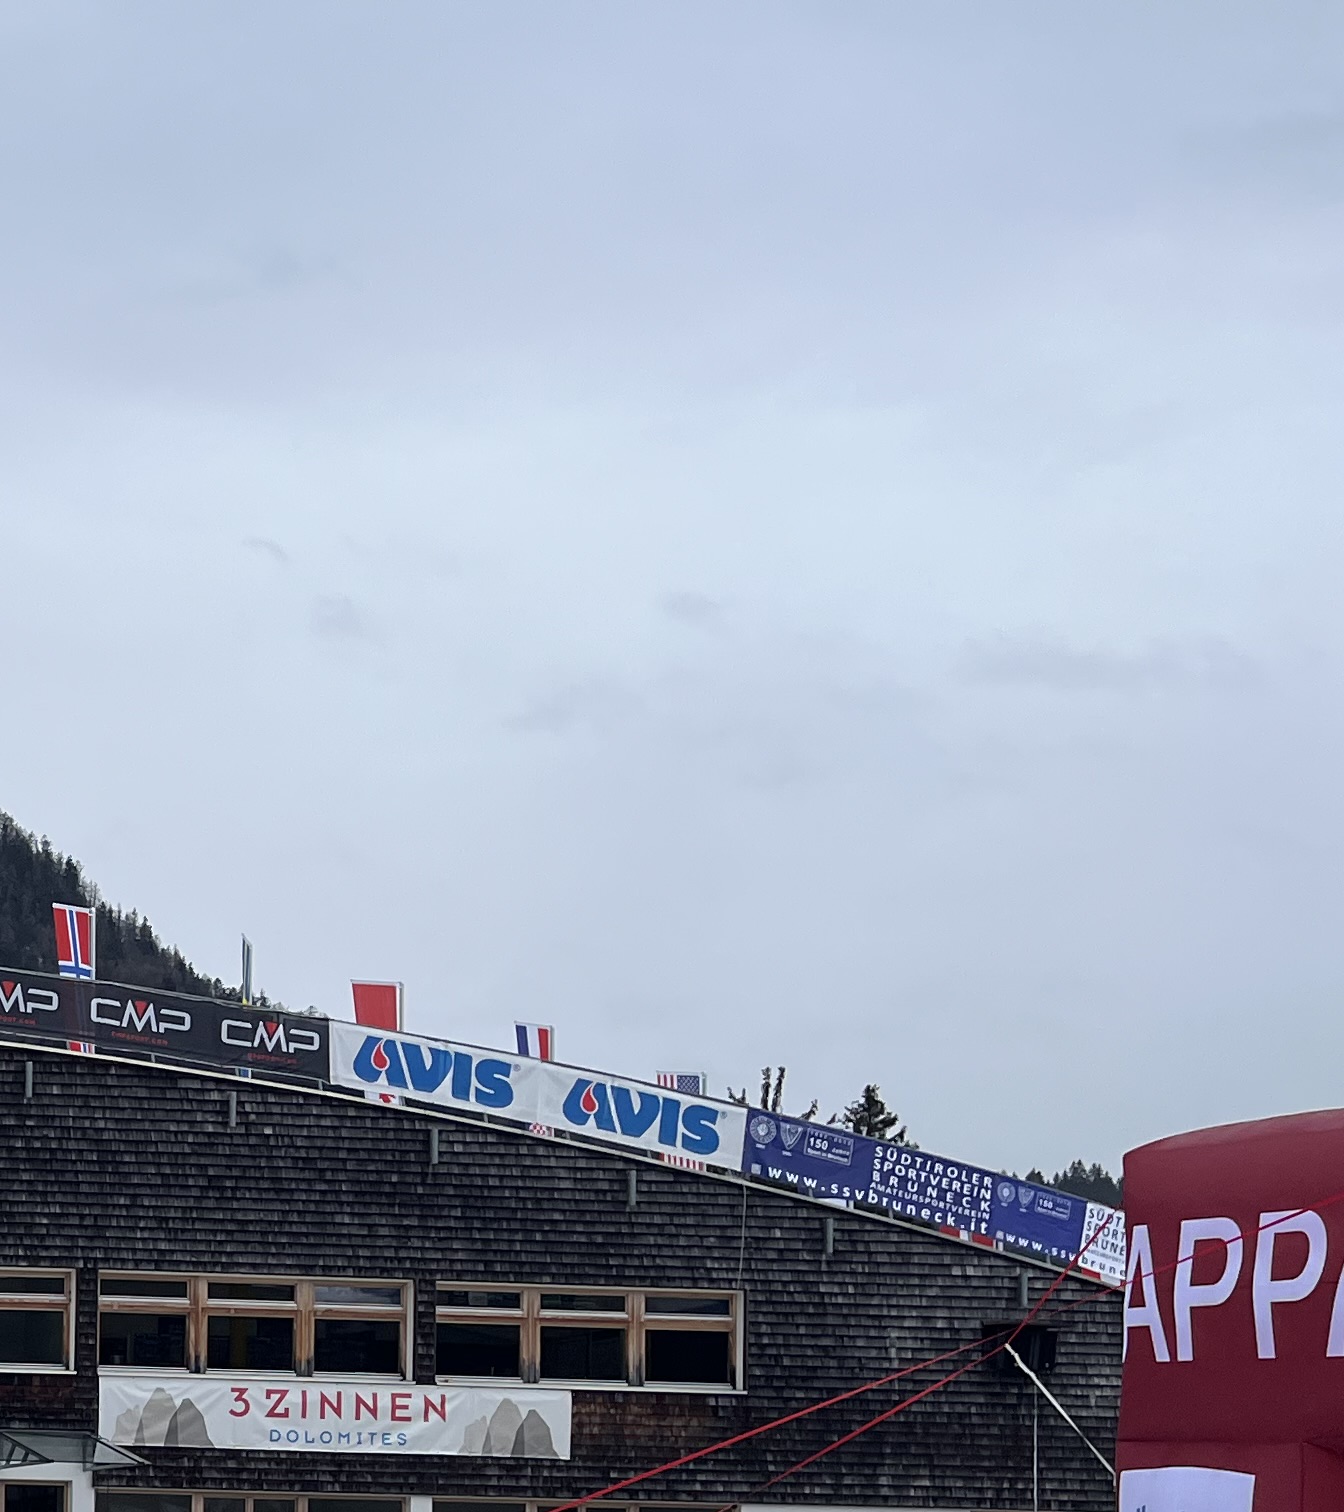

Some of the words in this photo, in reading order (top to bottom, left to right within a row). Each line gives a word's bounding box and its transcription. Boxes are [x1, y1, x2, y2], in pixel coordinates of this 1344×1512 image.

[90, 998, 191, 1034] CMP
[221, 1019, 320, 1053] CMP
[353, 1035, 514, 1109] AVIS
[562, 1077, 721, 1156] AVIS
[809, 1137, 829, 1151] 150
[873, 1158, 992, 1201] SPORTVEREIN
[874, 1145, 993, 1189] SÜDTIROLER
[768, 1166, 989, 1235] www.ssvbruneck.it
[872, 1171, 991, 1212] BRUNECK
[228, 1387, 252, 1417] 3
[264, 1389, 447, 1423] ZINNEN
[268, 1428, 408, 1447] DOLOMITES
